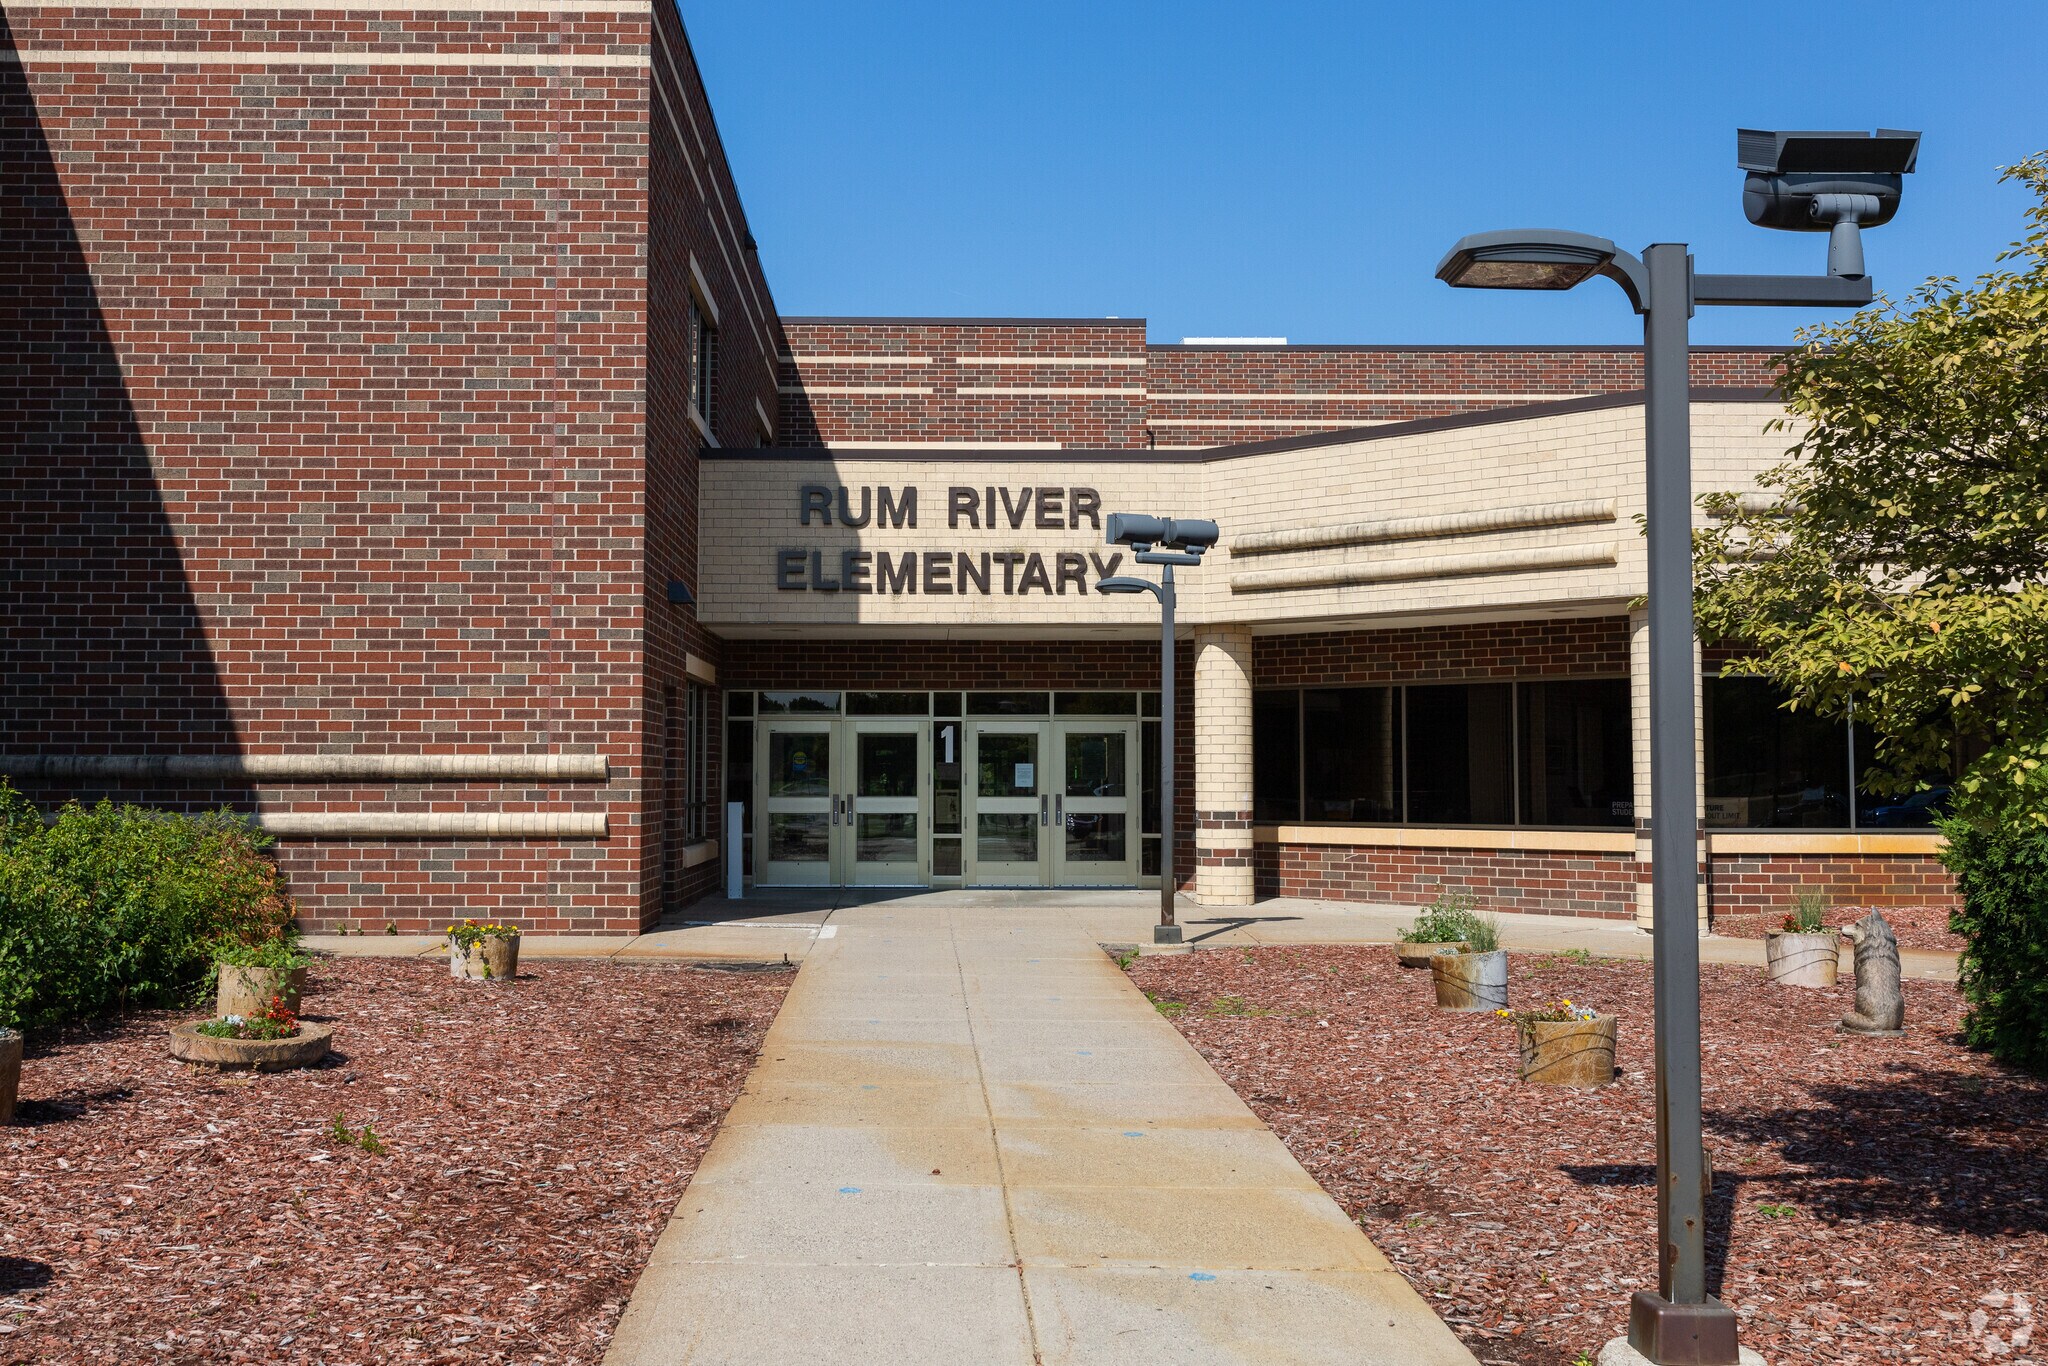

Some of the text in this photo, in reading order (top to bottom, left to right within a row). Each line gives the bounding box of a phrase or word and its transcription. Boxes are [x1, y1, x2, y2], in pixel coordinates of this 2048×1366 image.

[800, 486, 1101, 530] RUM RIVER
[778, 551, 1123, 595] ELEMENTARY
[940, 725, 954, 763] 1
[1611, 801, 1633, 809] PREPA
[1611, 808, 1633, 816] STUDE
